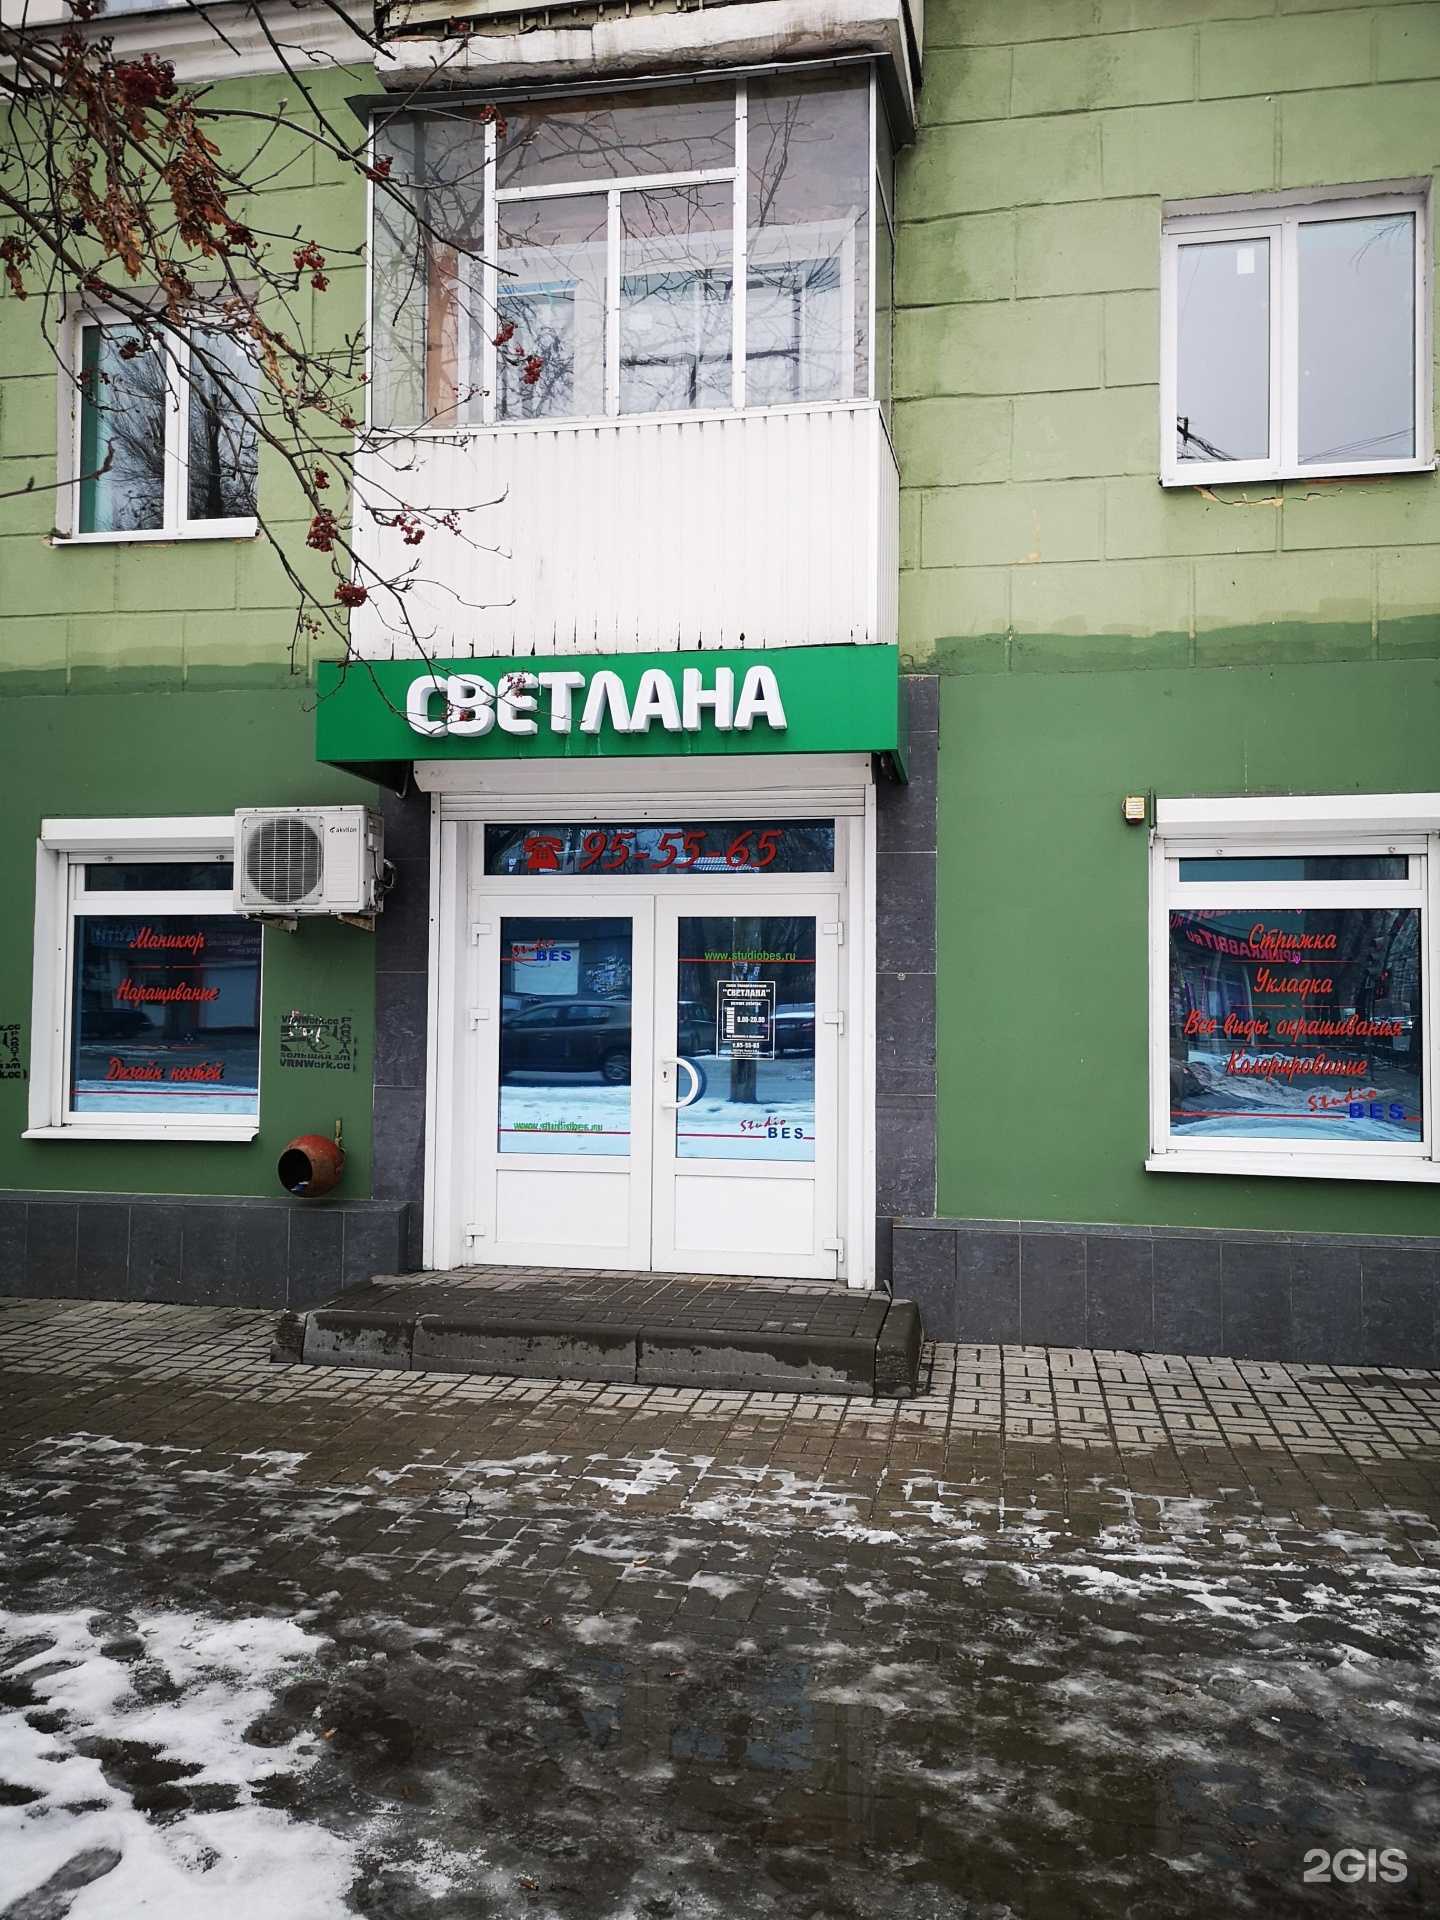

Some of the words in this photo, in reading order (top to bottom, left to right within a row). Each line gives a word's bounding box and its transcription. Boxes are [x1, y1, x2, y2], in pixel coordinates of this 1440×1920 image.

[406, 665, 788, 736] СВЕТЛАНА
[580, 830, 784, 870] 95-55-65
[128, 927, 205, 955] Маникюр
[1249, 923, 1337, 955] Стрижка
[536, 950, 572, 961] BES
[704, 951, 796, 961] www.studiobes.ru
[116, 978, 218, 1005] Наращивание
[1253, 967, 1333, 1000] Укладка
[1184, 1009, 1216, 1034] Все
[1224, 1014, 1269, 1041] виды
[1277, 1015, 1403, 1041] окрашивания
[107, 1056, 163, 1080] Дизайн
[1227, 1049, 1368, 1081] Колорирование
[1308, 1088, 1377, 1111] Studio
[1350, 1103, 1405, 1120] BES
[740, 1116, 786, 1132] Studio
[768, 1127, 803, 1139] BES
